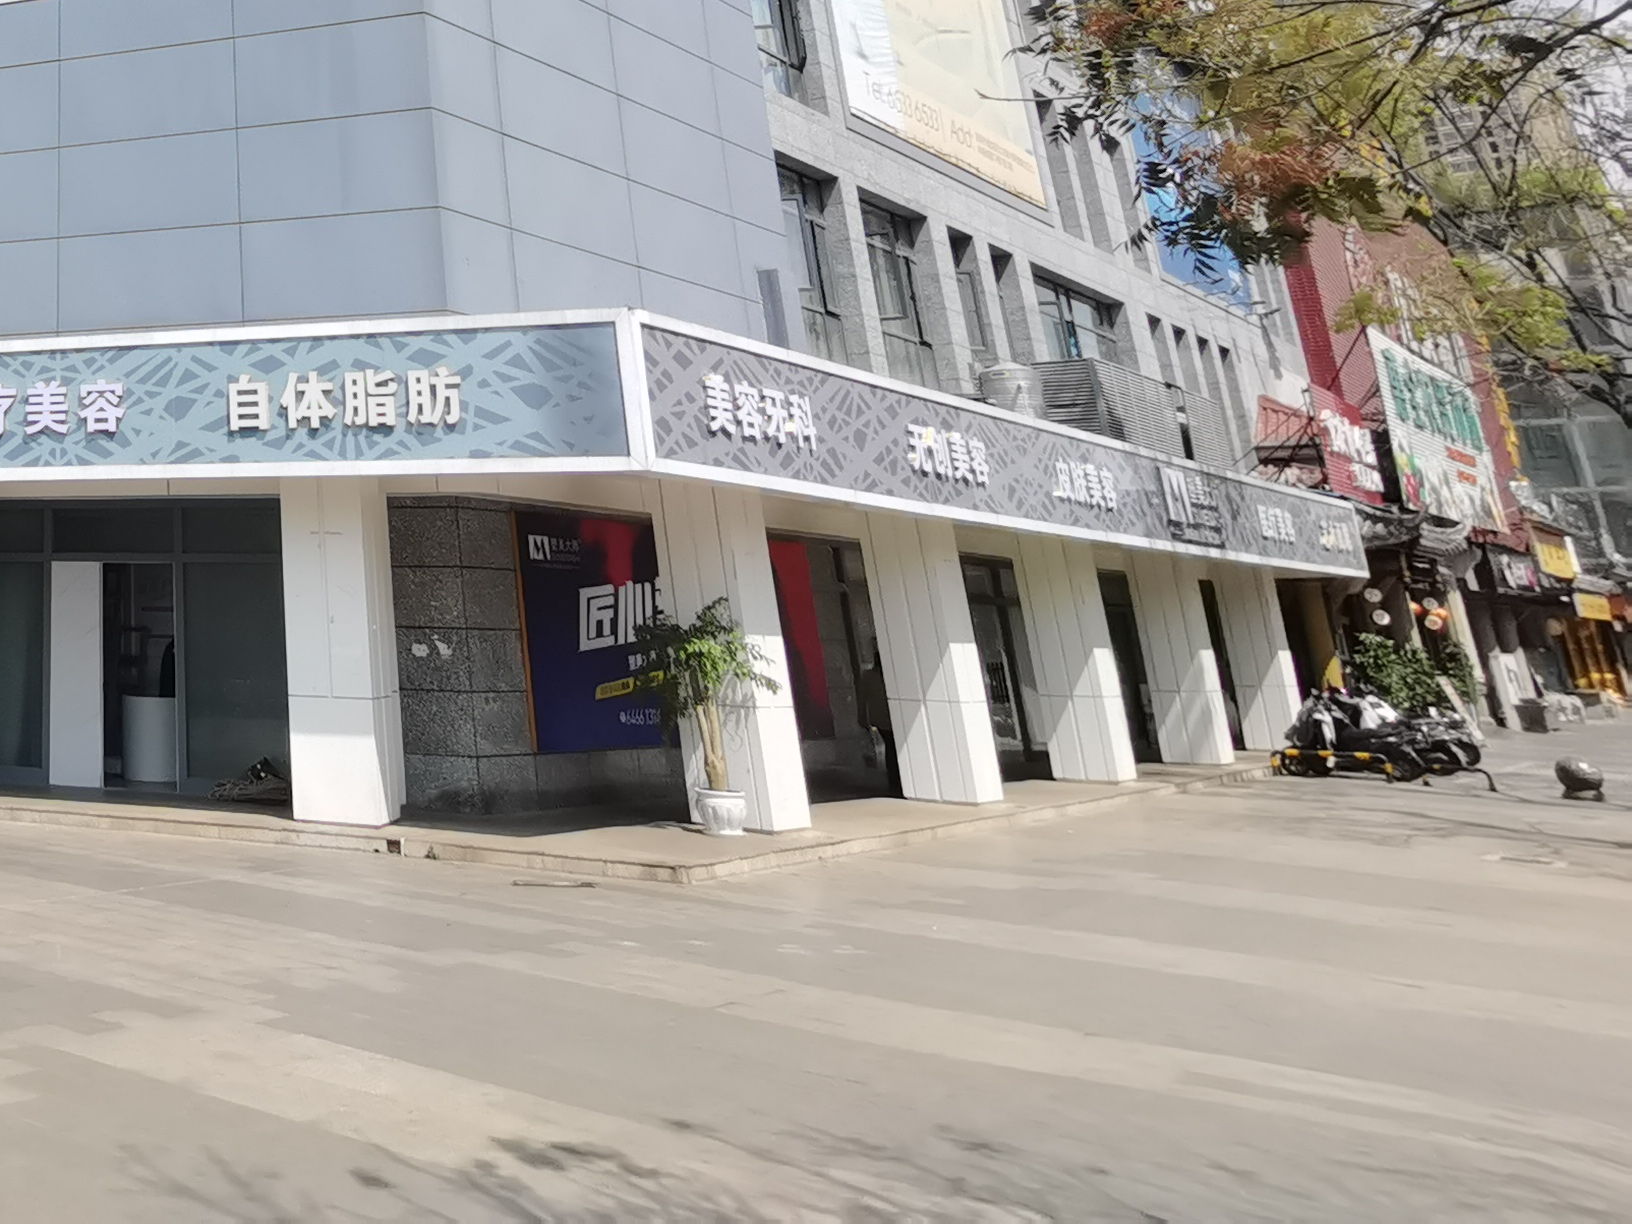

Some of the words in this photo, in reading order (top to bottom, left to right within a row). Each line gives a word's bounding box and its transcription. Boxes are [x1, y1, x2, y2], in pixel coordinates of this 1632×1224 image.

[226, 365, 463, 433] 自体脂肪
[702, 373, 817, 453] 美容牙科
